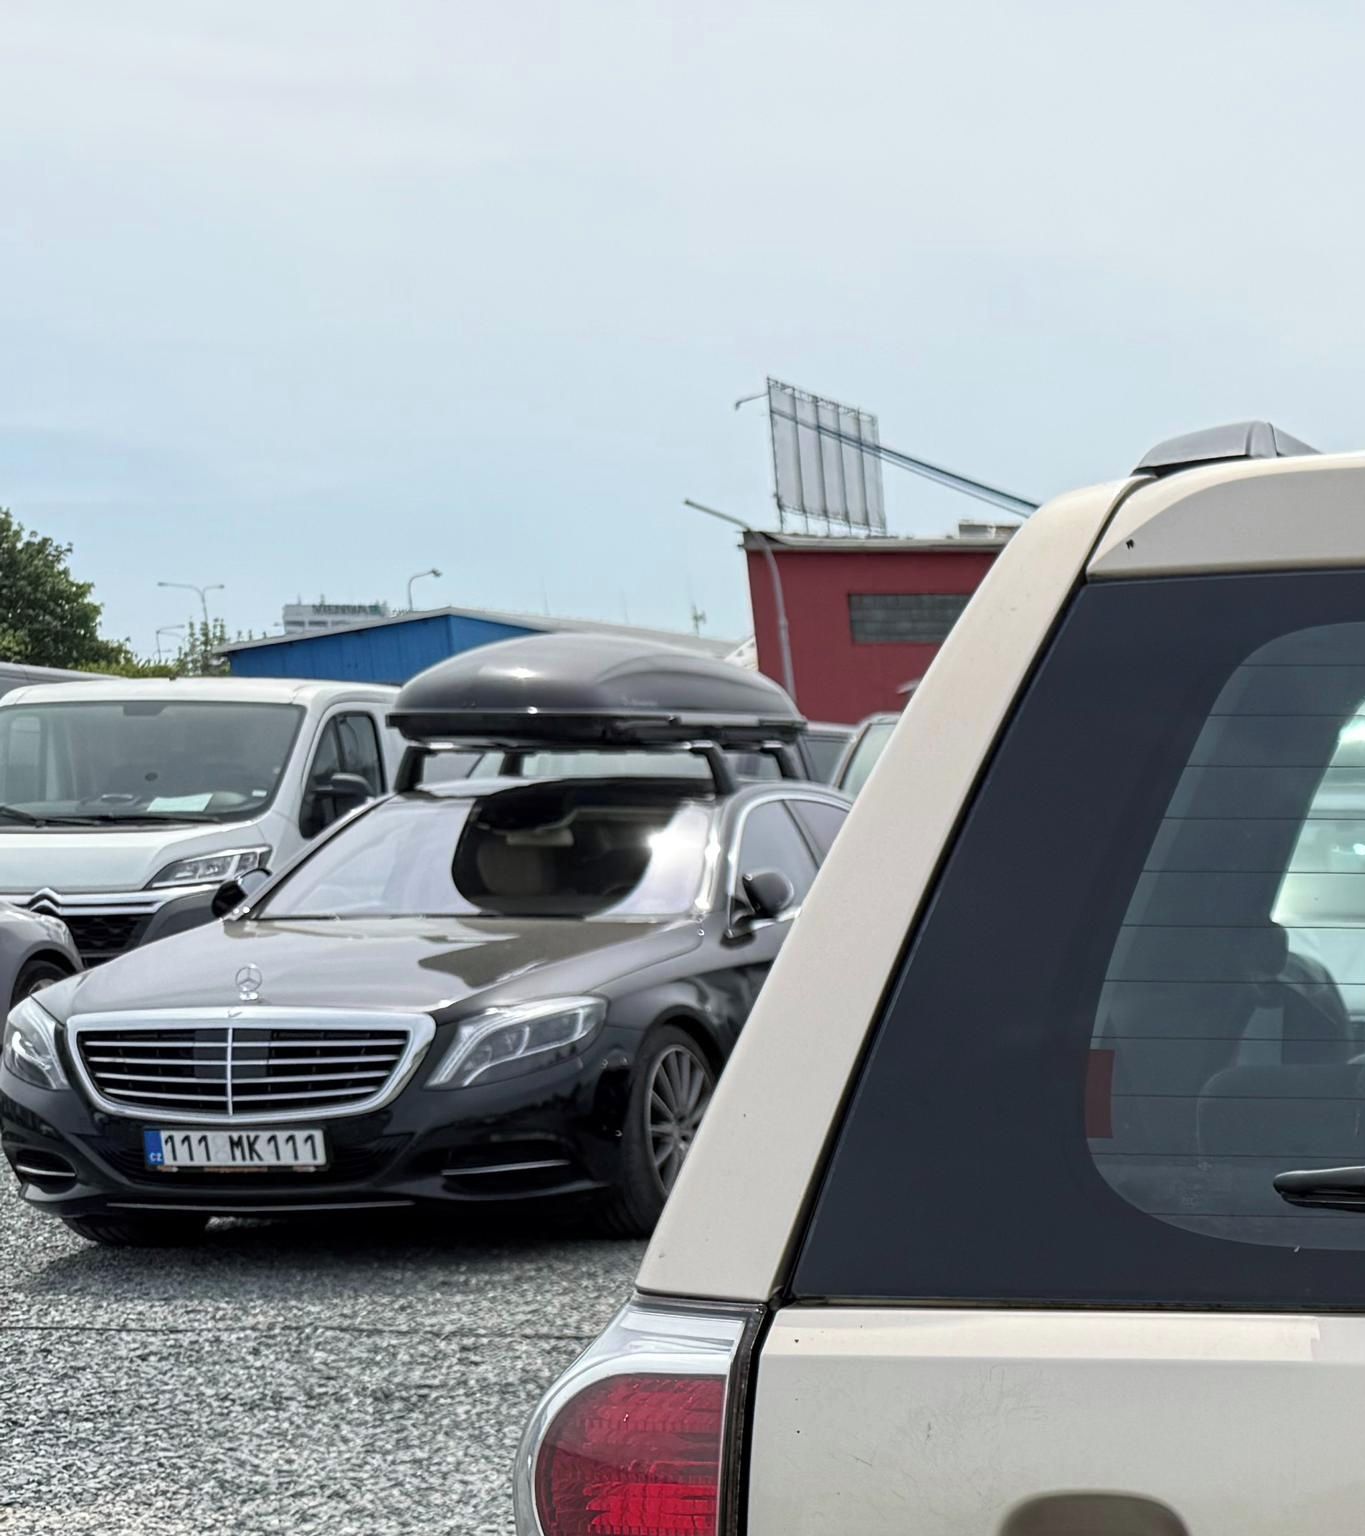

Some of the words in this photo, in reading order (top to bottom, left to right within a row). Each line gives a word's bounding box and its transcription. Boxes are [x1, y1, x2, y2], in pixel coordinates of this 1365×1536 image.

[165, 1134, 211, 1162] 111
[229, 1134, 318, 1162] MK111
[149, 1153, 163, 1162] CZ
